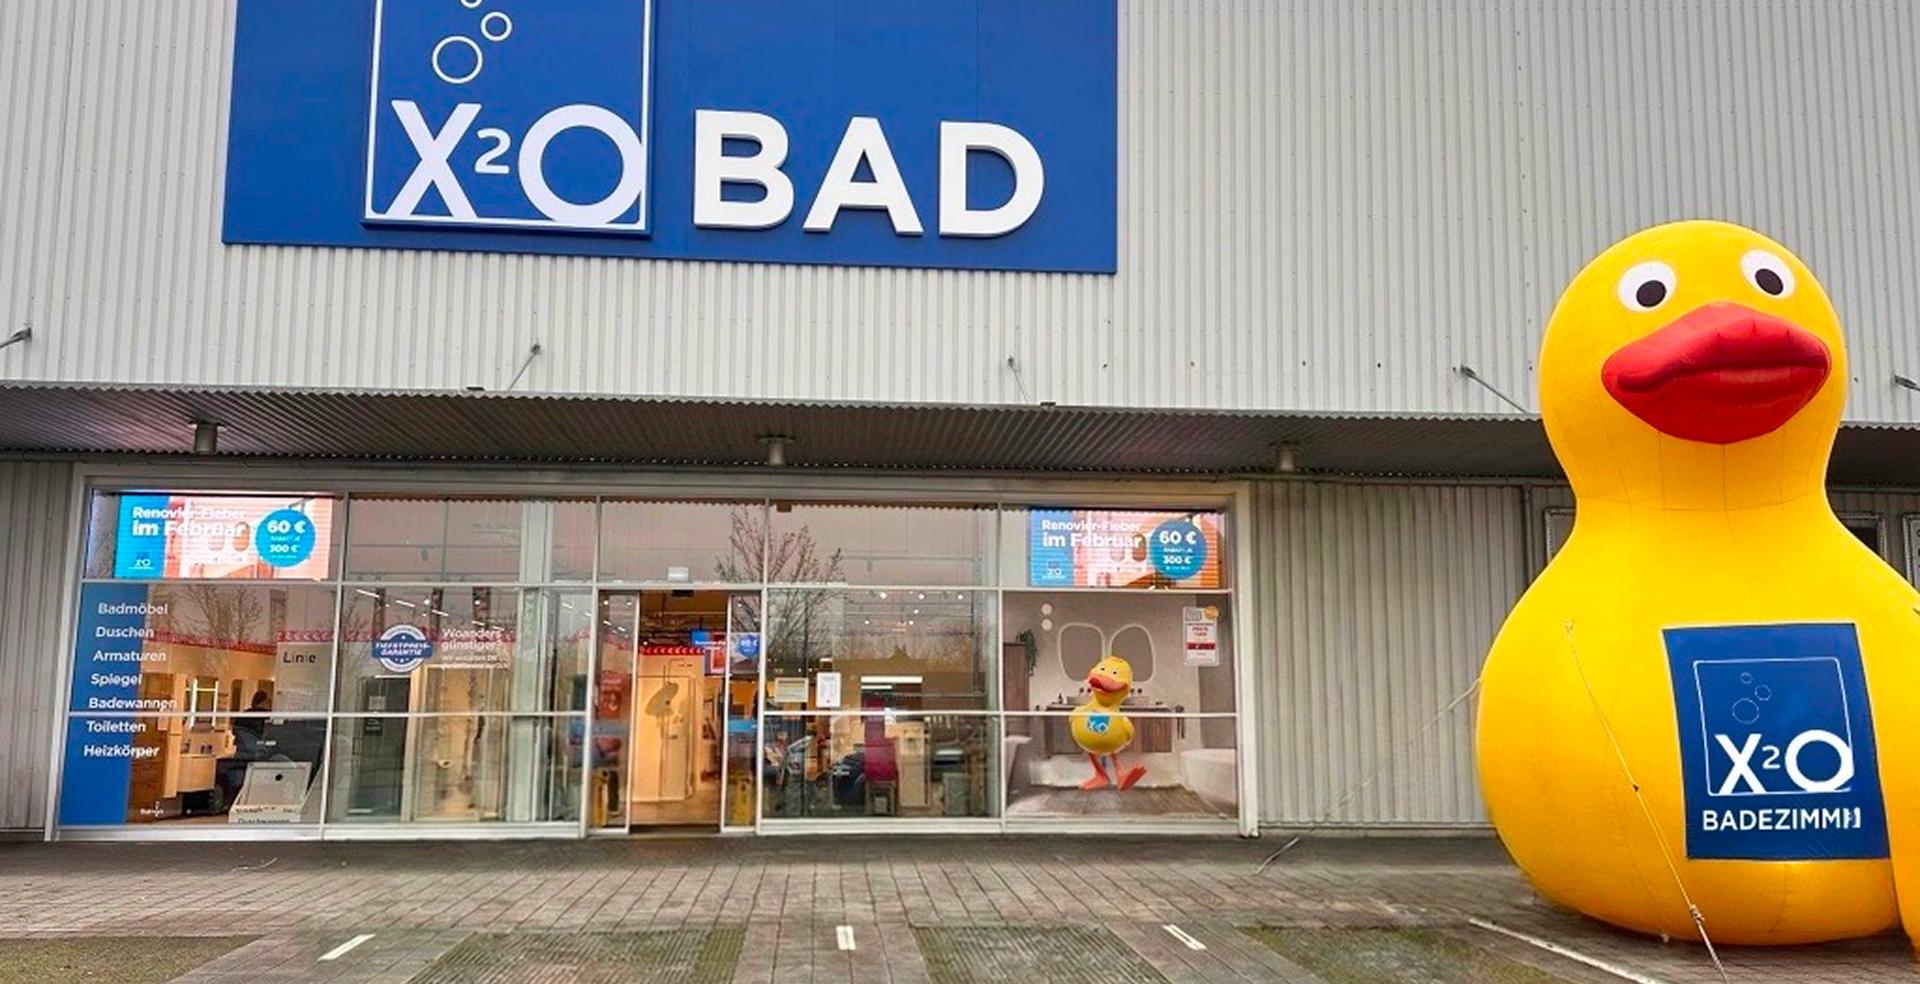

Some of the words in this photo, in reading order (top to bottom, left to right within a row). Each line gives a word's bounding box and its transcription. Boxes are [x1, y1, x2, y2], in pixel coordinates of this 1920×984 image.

[693, 108, 1046, 238] BAD
[132, 519, 159, 536] im
[163, 521, 246, 538] Februar
[267, 520, 291, 534] 60
[294, 520, 307, 535] €
[1043, 531, 1066, 548] im
[1070, 532, 1143, 549] Februar
[1159, 530, 1182, 545] 60
[1185, 531, 1198, 546] €
[268, 544, 290, 553] 300
[1162, 555, 1183, 565] 300
[97, 601, 169, 616] Badmöbel
[95, 625, 155, 639] Duschen
[92, 649, 168, 663] Armaturen
[282, 651, 316, 664] Linie
[90, 673, 143, 688] Spiegel
[88, 696, 178, 711] Badewannen
[86, 720, 147, 734] Toiletten
[83, 743, 160, 759] Heizkörper
